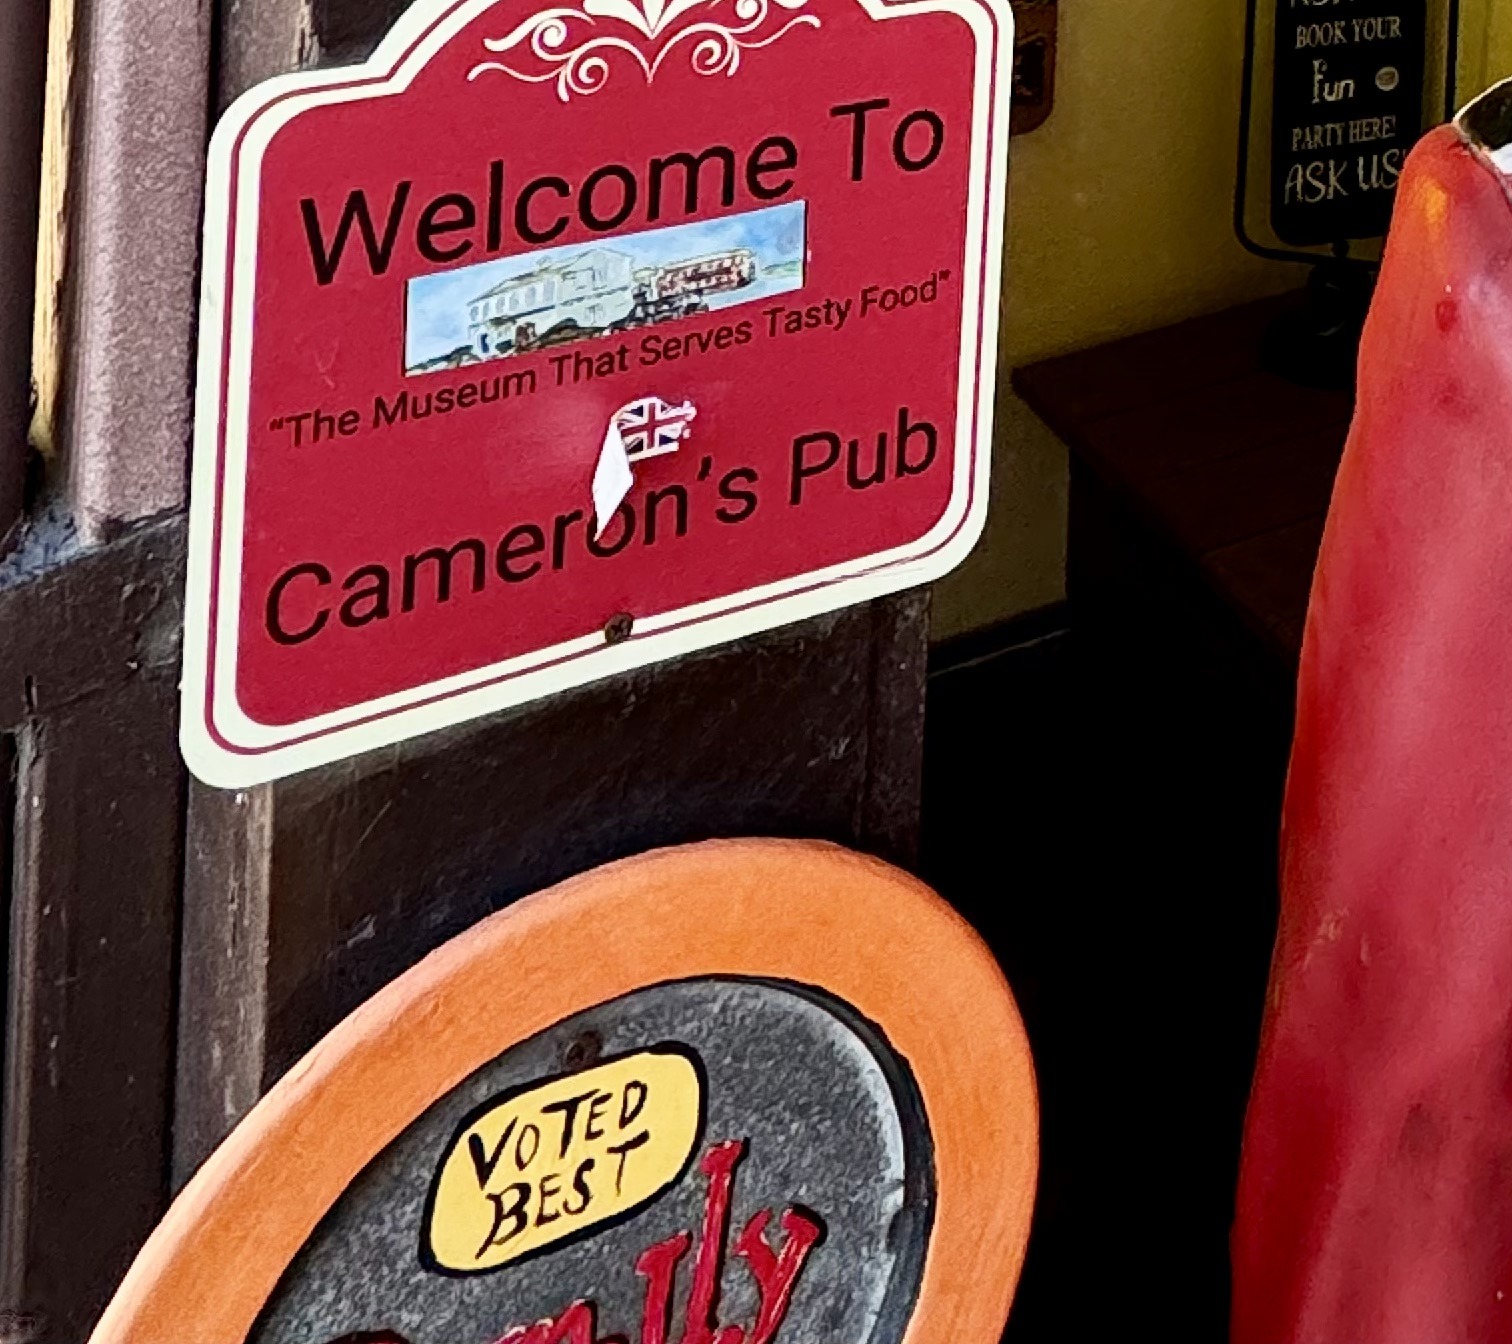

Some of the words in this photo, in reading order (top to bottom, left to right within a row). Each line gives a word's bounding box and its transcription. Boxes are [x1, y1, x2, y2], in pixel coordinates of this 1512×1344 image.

[1295, 19, 1347, 49] BOOK
[1350, 15, 1402, 43] YOUR
[1311, 58, 1355, 104] Fun
[1284, 158, 1350, 205] ASK
[1292, 121, 1347, 152] PARTY
[300, 134, 798, 288] Welcome
[831, 97, 945, 185] To
[268, 404, 361, 449] "The
[372, 368, 537, 429] Museum
[550, 343, 629, 389] That
[638, 318, 753, 368] Serves
[762, 293, 851, 340] Tasty
[859, 269, 952, 319] Food"
[264, 455, 759, 647] Cameron's
[790, 406, 938, 508] Pub
[468, 1080, 648, 1191] VOTED
[475, 1129, 651, 1260] BEST
